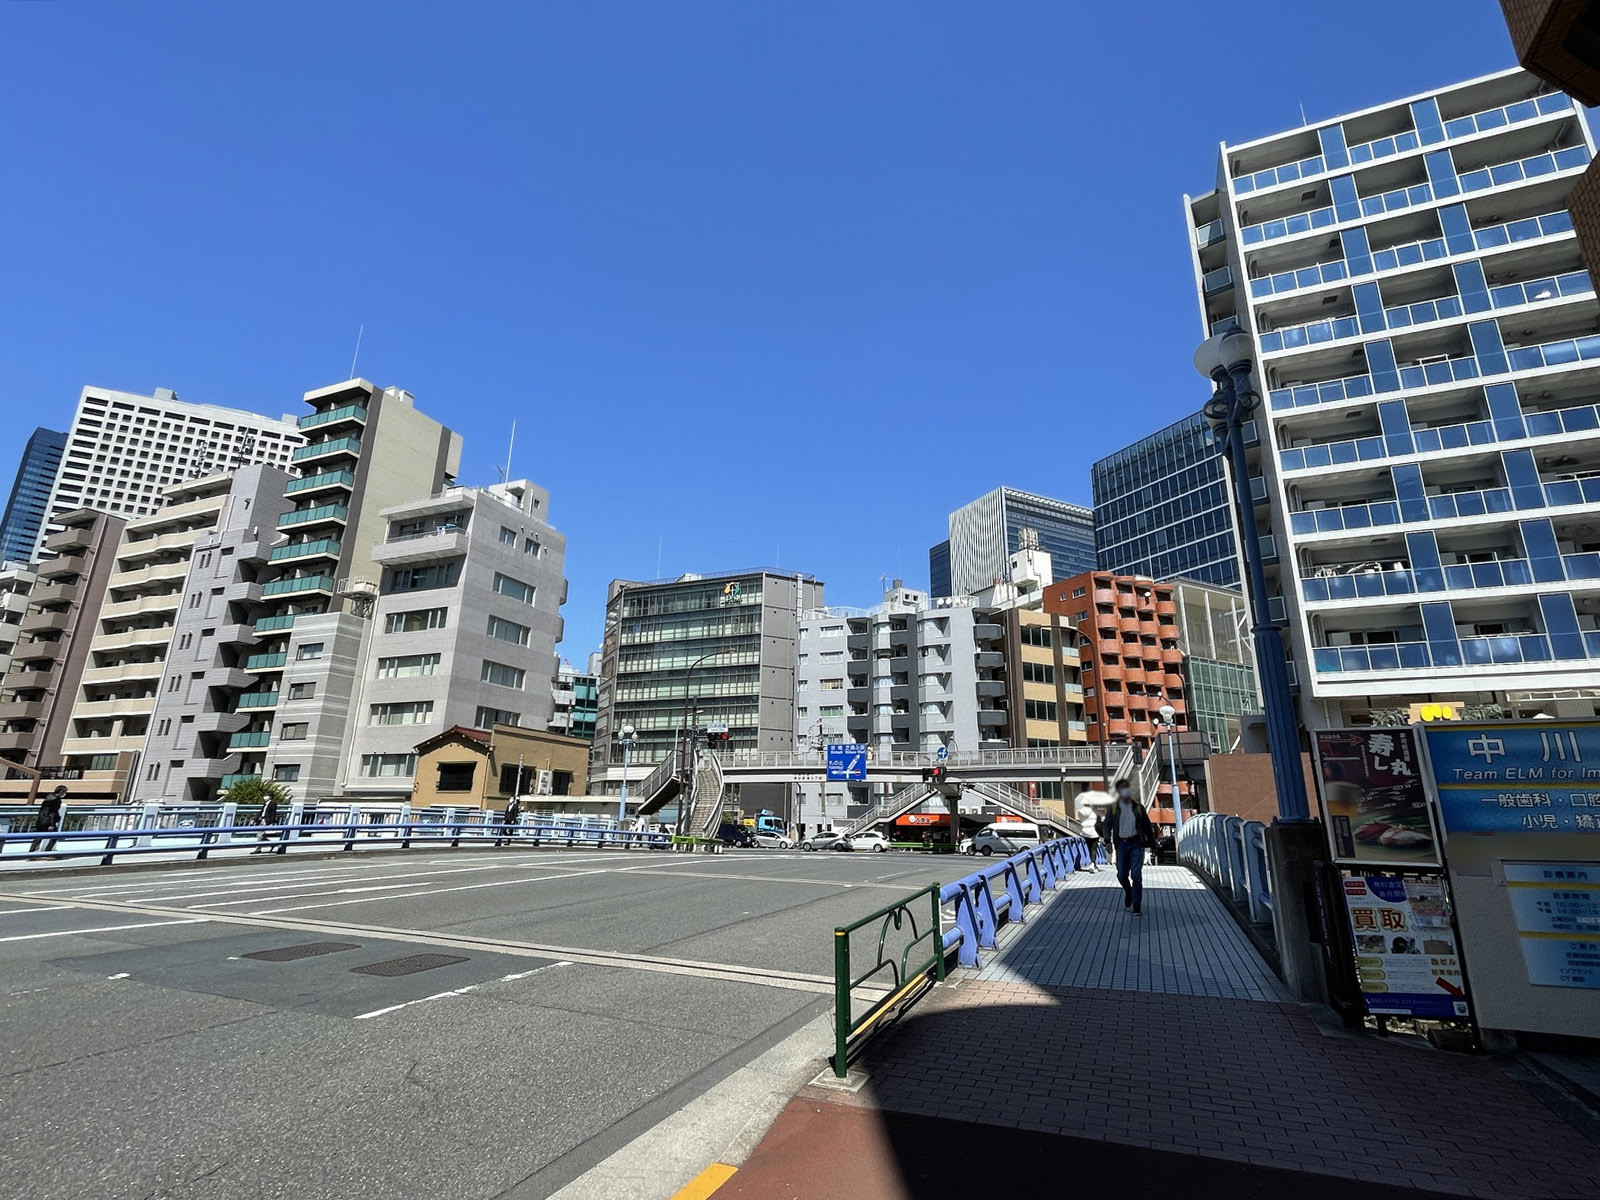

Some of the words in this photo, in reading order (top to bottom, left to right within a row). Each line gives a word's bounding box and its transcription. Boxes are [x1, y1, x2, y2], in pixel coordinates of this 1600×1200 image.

[1453, 768, 1497, 780] Team
[1506, 767, 1543, 780] ELM
[1552, 767, 1574, 778] for
[1353, 908, 1407, 931] 買取
